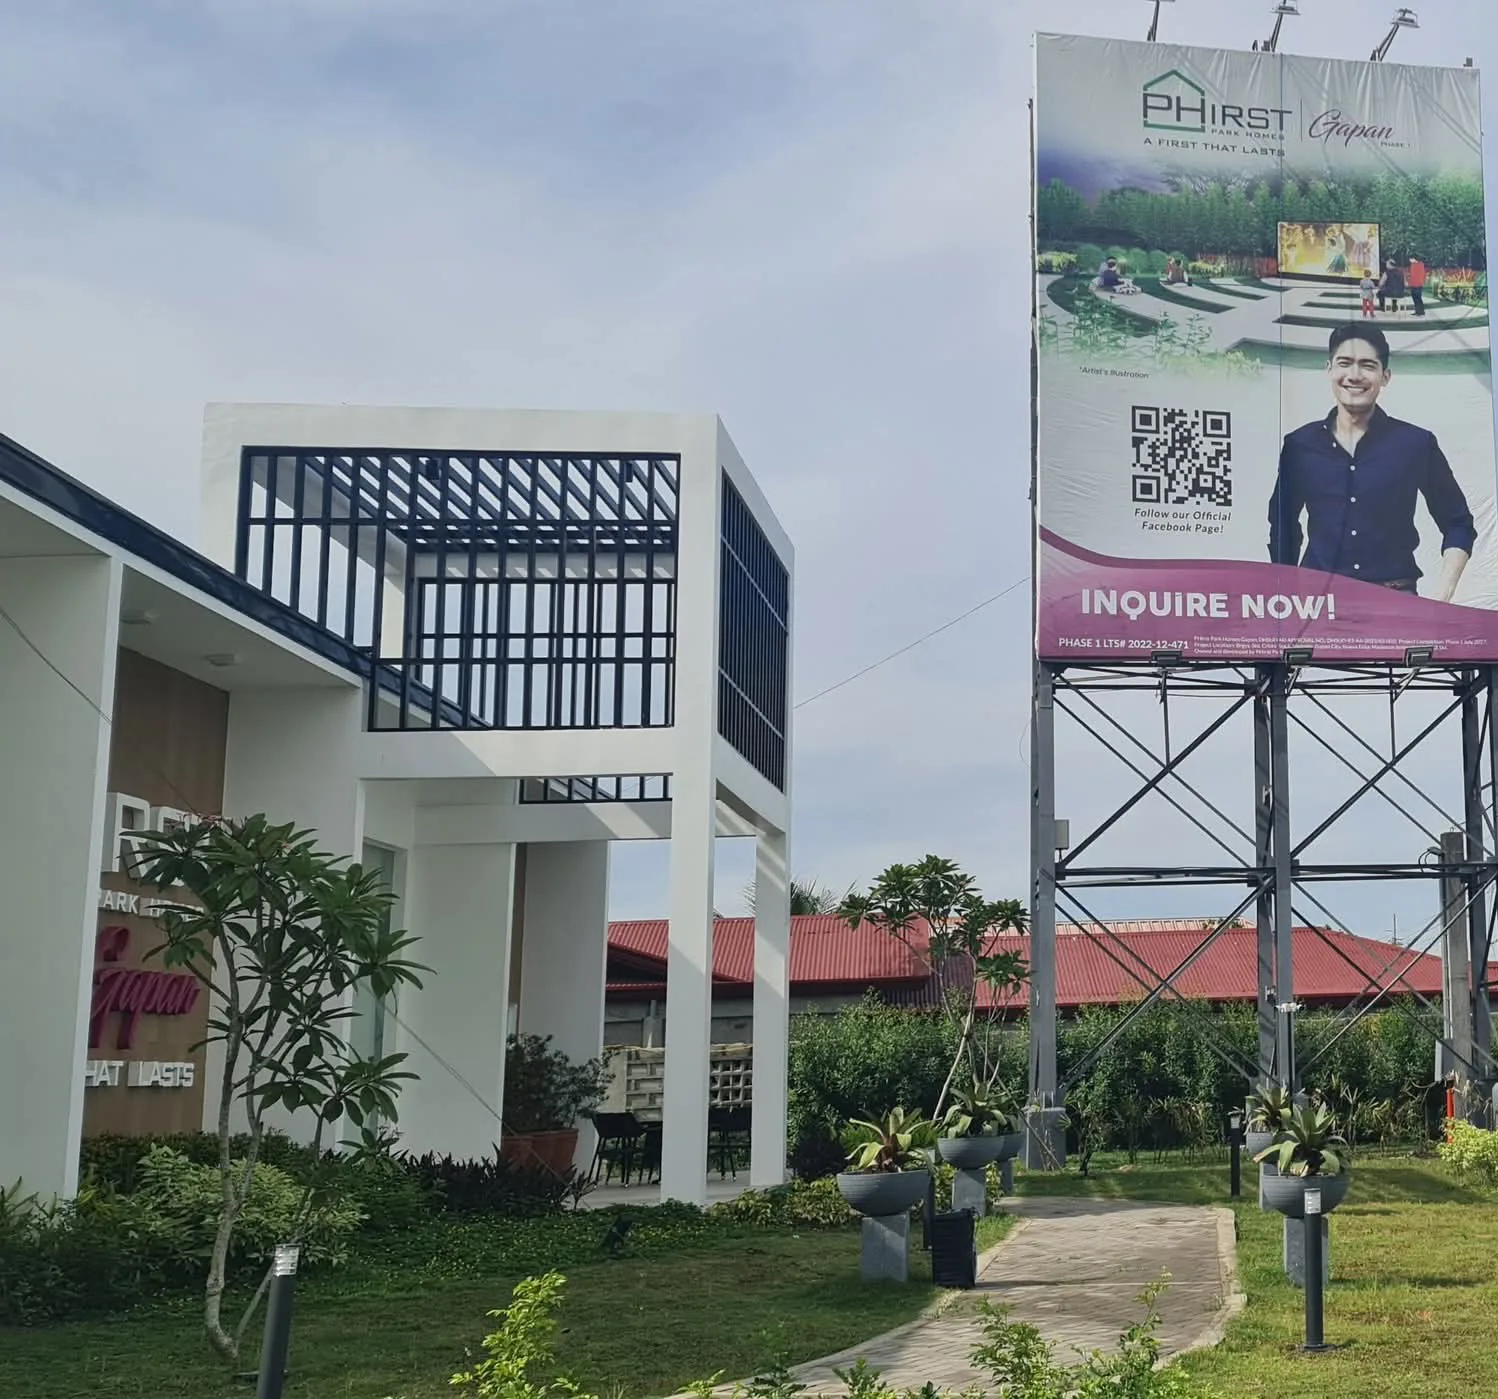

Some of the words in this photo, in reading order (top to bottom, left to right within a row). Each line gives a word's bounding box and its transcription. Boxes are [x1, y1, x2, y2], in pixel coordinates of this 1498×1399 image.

[1211, 128, 1239, 137] PARK
[1309, 109, 1392, 148] Gapan
[1143, 137, 1152, 145] A
[1158, 138, 1197, 149] FIRST
[1202, 143, 1237, 153] THAT
[1242, 146, 1286, 157] LASTS
[1134, 507, 1169, 519] Follow
[1172, 509, 1190, 520] our
[1193, 509, 1231, 521] Official
[1142, 521, 1192, 532] Facebook
[1195, 523, 1224, 534] Page!
[1081, 588, 1229, 621] INQUIRE
[1241, 593, 1336, 621] NOW!
[1058, 637, 1093, 649] PHASE
[1095, 638, 1101, 649] 1
[1103, 638, 1126, 649] LTS#
[1127, 639, 1189, 650] 2022-12-471
[129, 1061, 194, 1088] LASTS
